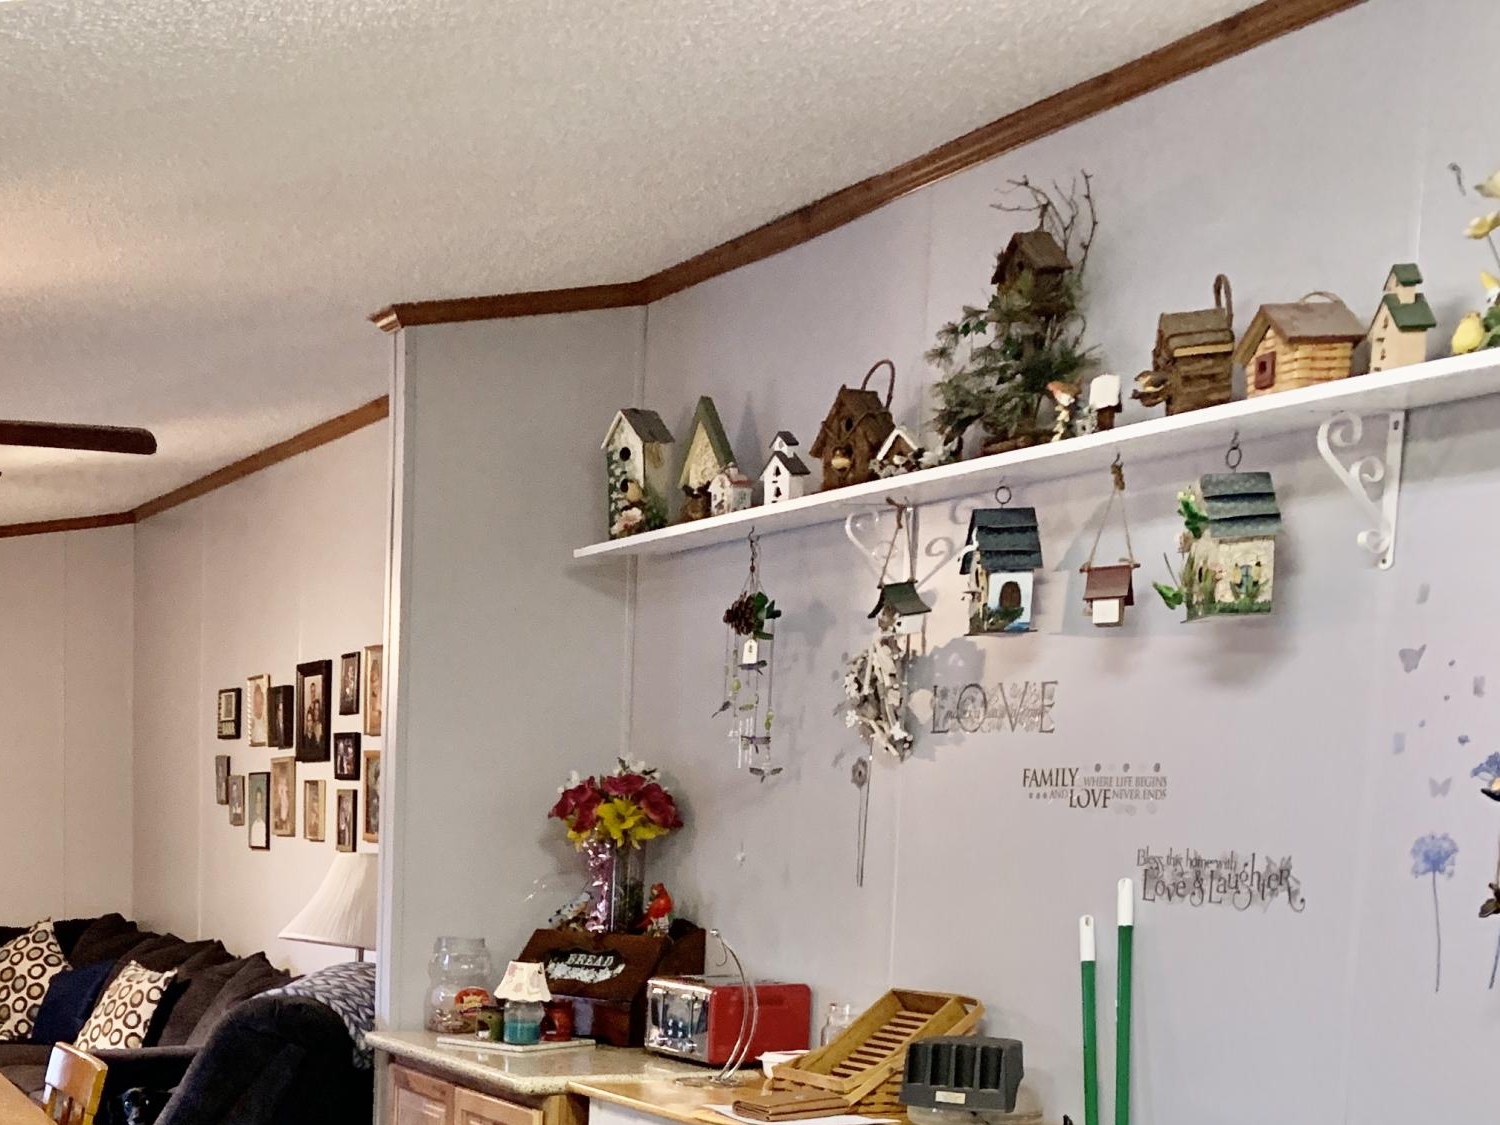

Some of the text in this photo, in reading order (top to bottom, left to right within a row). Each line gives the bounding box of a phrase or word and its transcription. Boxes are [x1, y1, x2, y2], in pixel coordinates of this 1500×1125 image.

[931, 680, 1058, 734] LOVE
[1022, 767, 1168, 788] FAMILY WHERE LIFE BEGINS
[1050, 788, 1167, 808] AND LOVE NEVER ENDS
[1142, 868, 1187, 902] Love
[565, 953, 614, 967] BREAD
